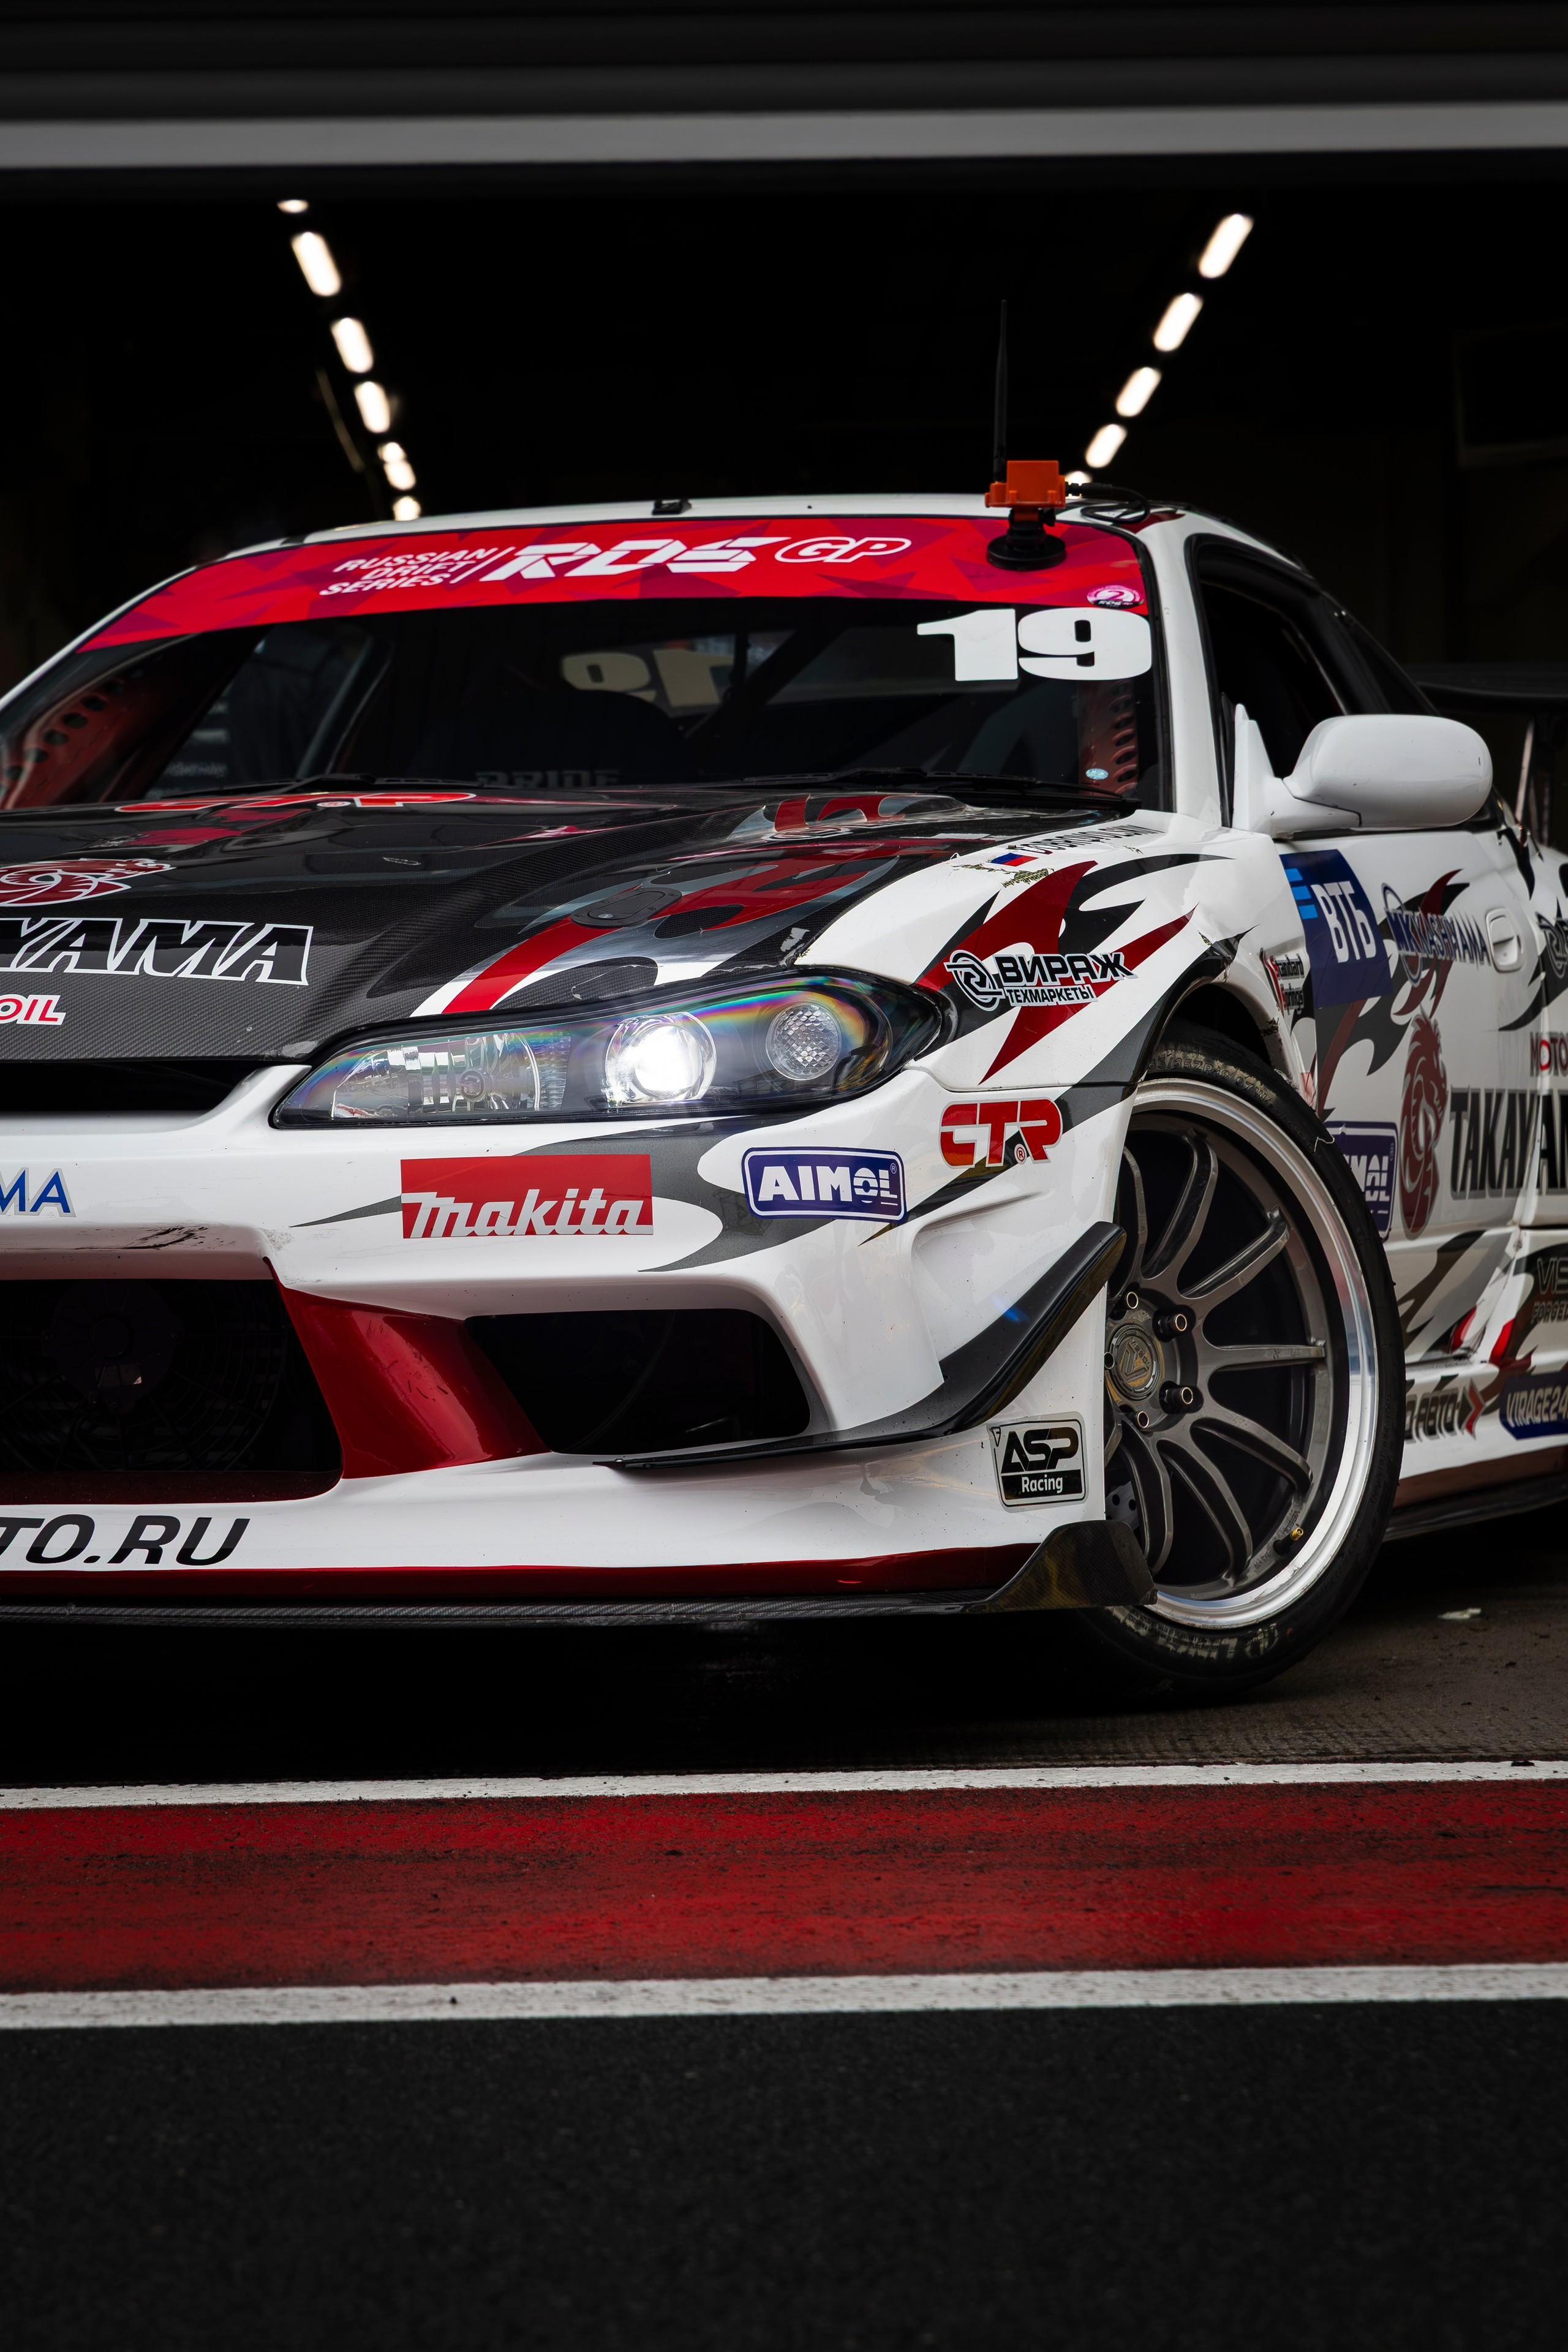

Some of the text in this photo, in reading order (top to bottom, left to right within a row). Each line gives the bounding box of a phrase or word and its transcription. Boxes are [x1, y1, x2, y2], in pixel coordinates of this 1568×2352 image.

[333, 548, 499, 572] RUSSIAN
[774, 537, 911, 563] GP
[319, 573, 451, 595] SERIES
[361, 560, 477, 580] DRIFT
[917, 607, 1152, 681] 19
[993, 952, 1137, 986] ВИРАЖ
[1006, 986, 1095, 1004] ТЕХМАРКЕТЫ
[1147, 1057, 1229, 1080] 65/35ZR18
[1530, 1031, 1568, 1077] MOTO
[939, 1099, 1063, 1168] CTR
[758, 1166, 899, 1205] AIMOL
[1343, 1154, 1390, 1202] MOL
[1001, 1427, 1079, 1474] ASP
[1022, 1474, 1063, 1493] Racing
[0, 1514, 251, 1566] TO.RU
